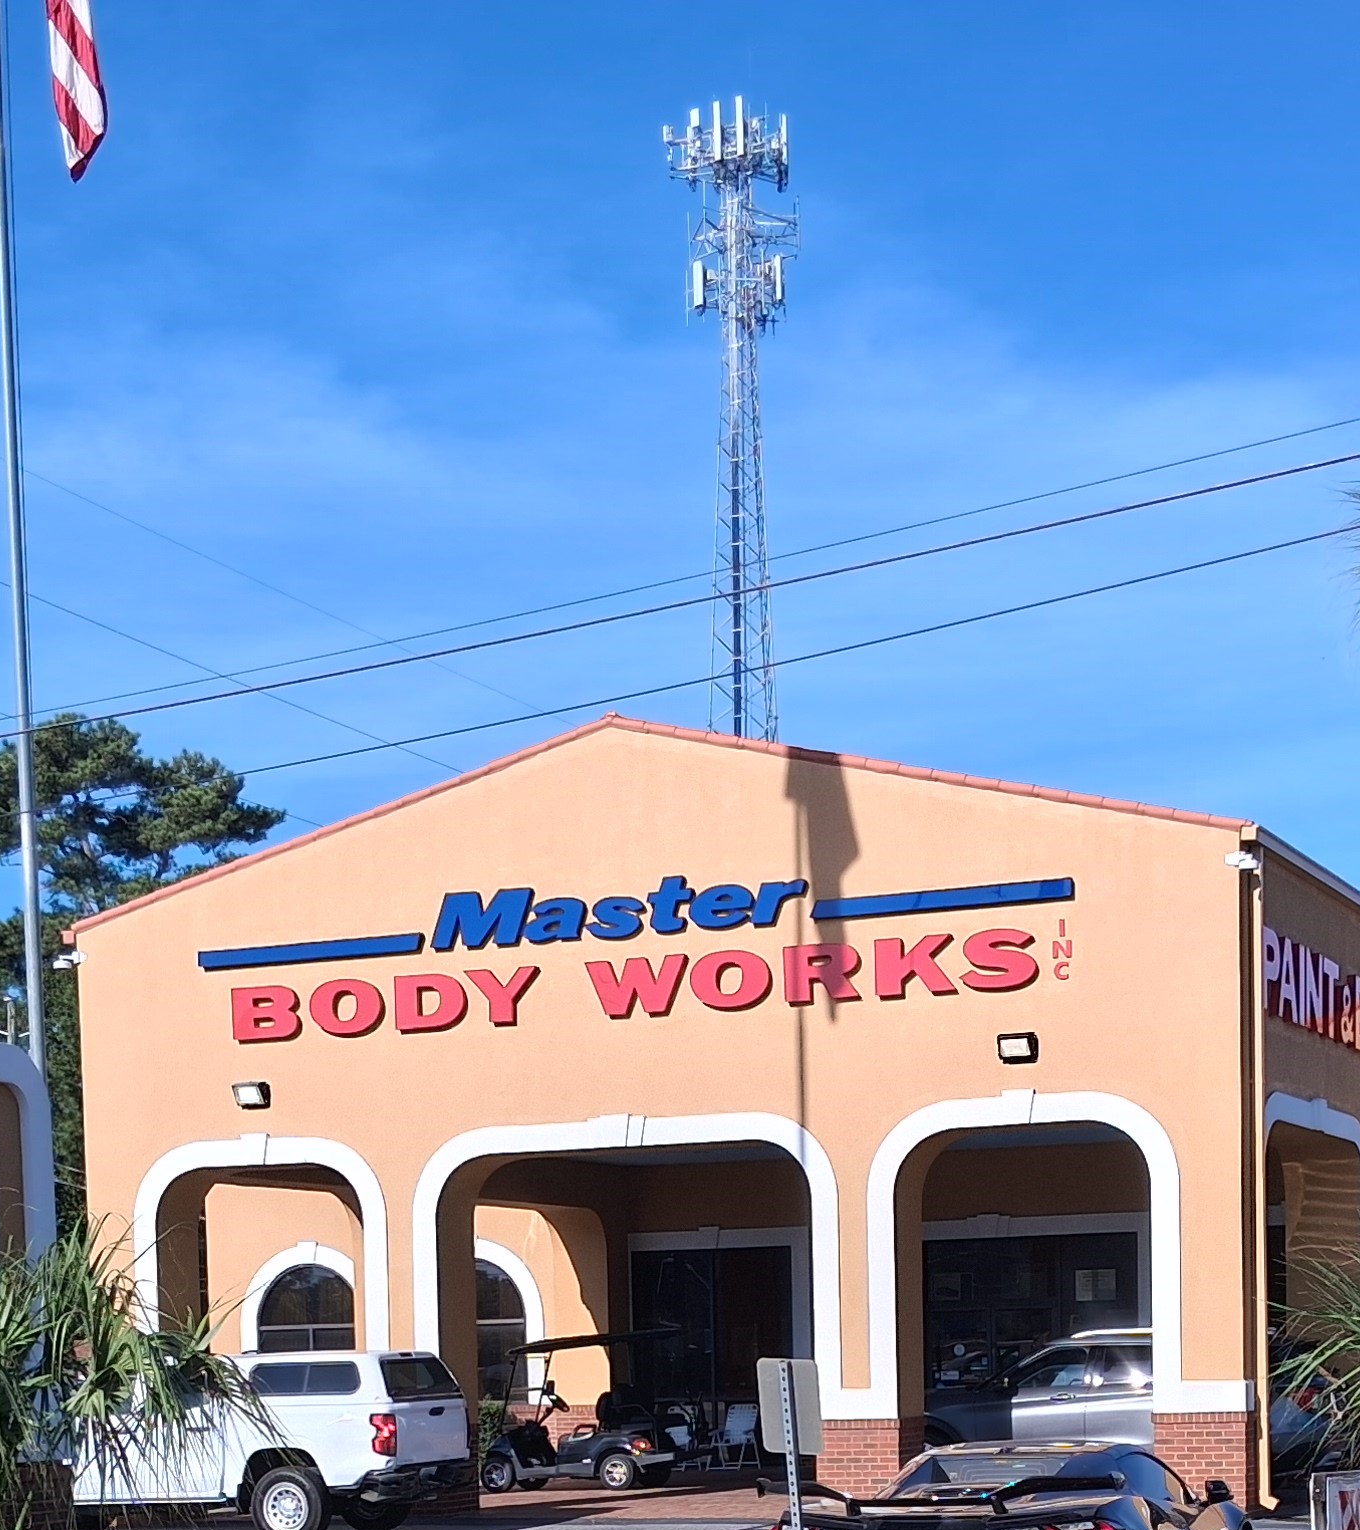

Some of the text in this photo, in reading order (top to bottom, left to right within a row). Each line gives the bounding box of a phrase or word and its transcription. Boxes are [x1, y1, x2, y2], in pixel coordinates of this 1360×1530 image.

[431, 874, 808, 951] Master
[1052, 919, 1072, 980] INC
[231, 927, 1039, 1043] BODY WORKS
[1264, 926, 1340, 1039] PAINT
[1341, 984, 1354, 1044] &
